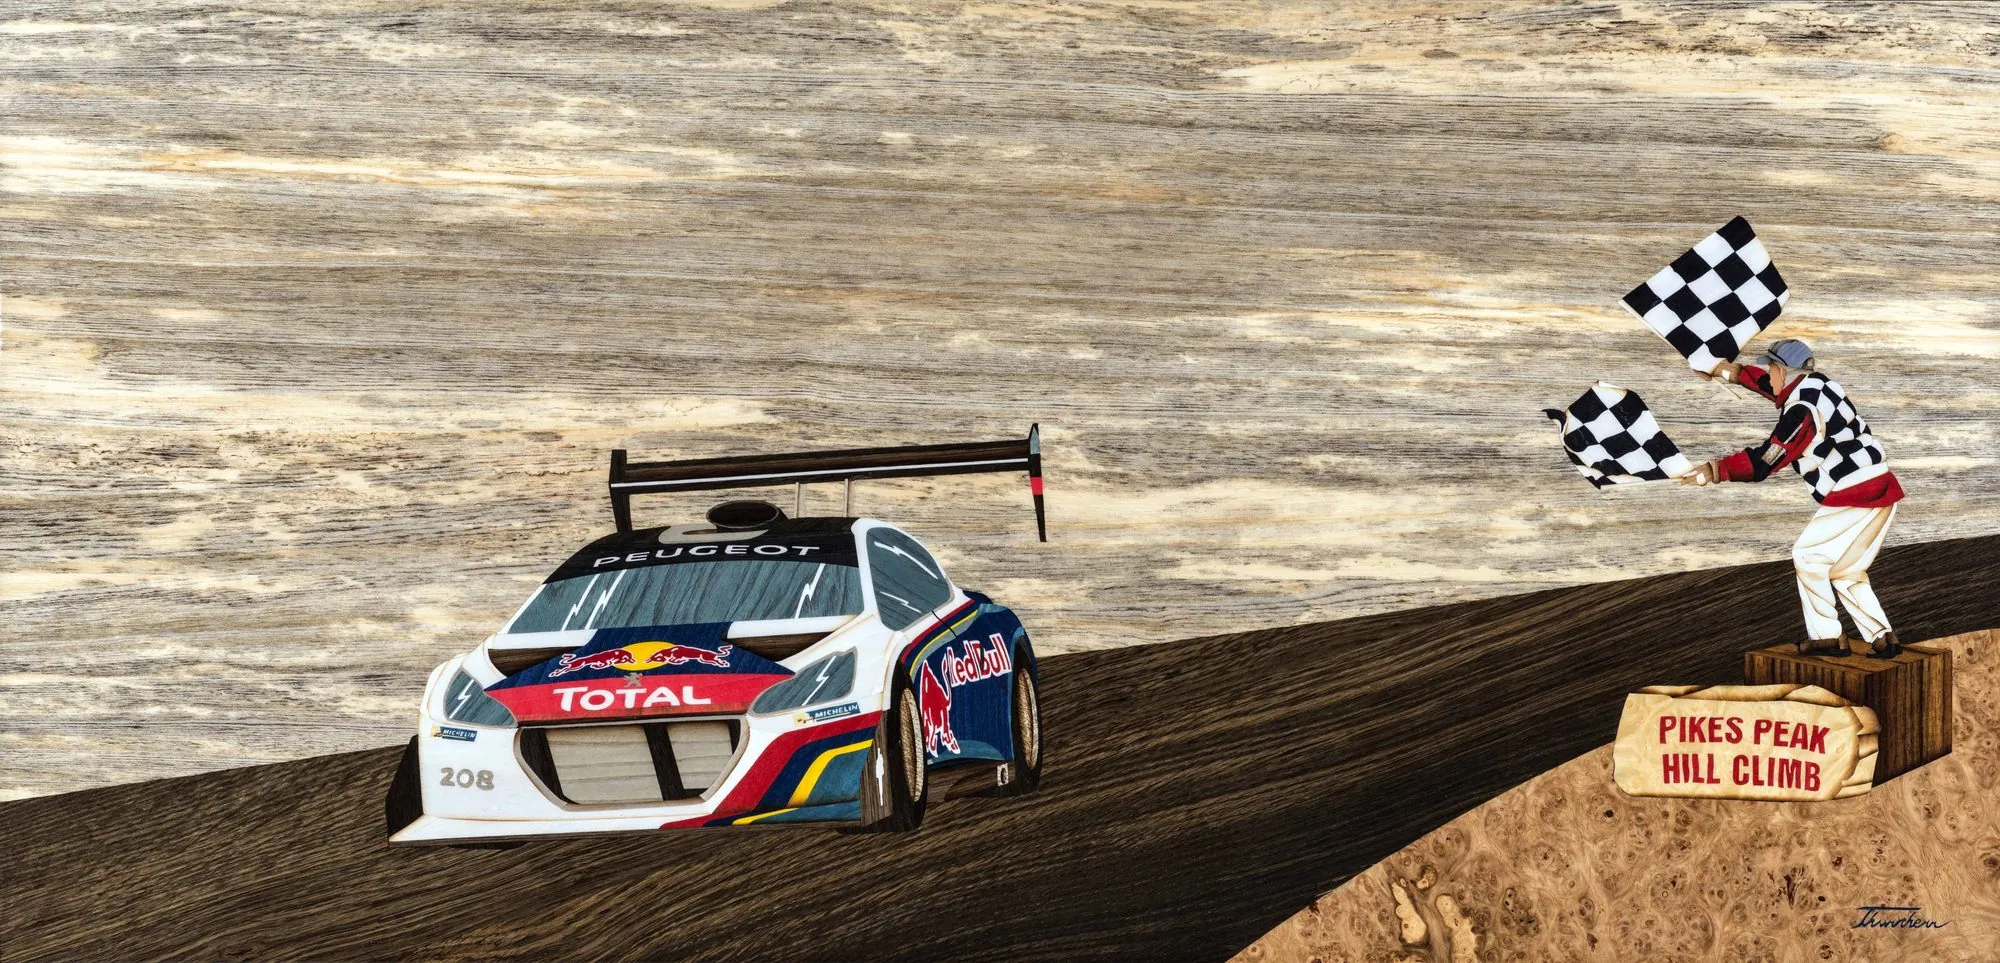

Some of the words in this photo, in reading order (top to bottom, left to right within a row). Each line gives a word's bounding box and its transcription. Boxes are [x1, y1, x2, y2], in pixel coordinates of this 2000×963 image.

[592, 544, 820, 568] PEUGEOT
[947, 640, 980, 687] Red
[970, 633, 1012, 680] Bull
[553, 685, 712, 712] TOTAL
[814, 704, 858, 718] MICHELIN
[442, 729, 476, 738] MICHELIN
[1659, 715, 1744, 744] PIKES
[1753, 719, 1830, 754] PEAK
[440, 767, 495, 791] 208
[1662, 753, 1721, 785] HILL
[1732, 754, 1821, 792] CLIMB
